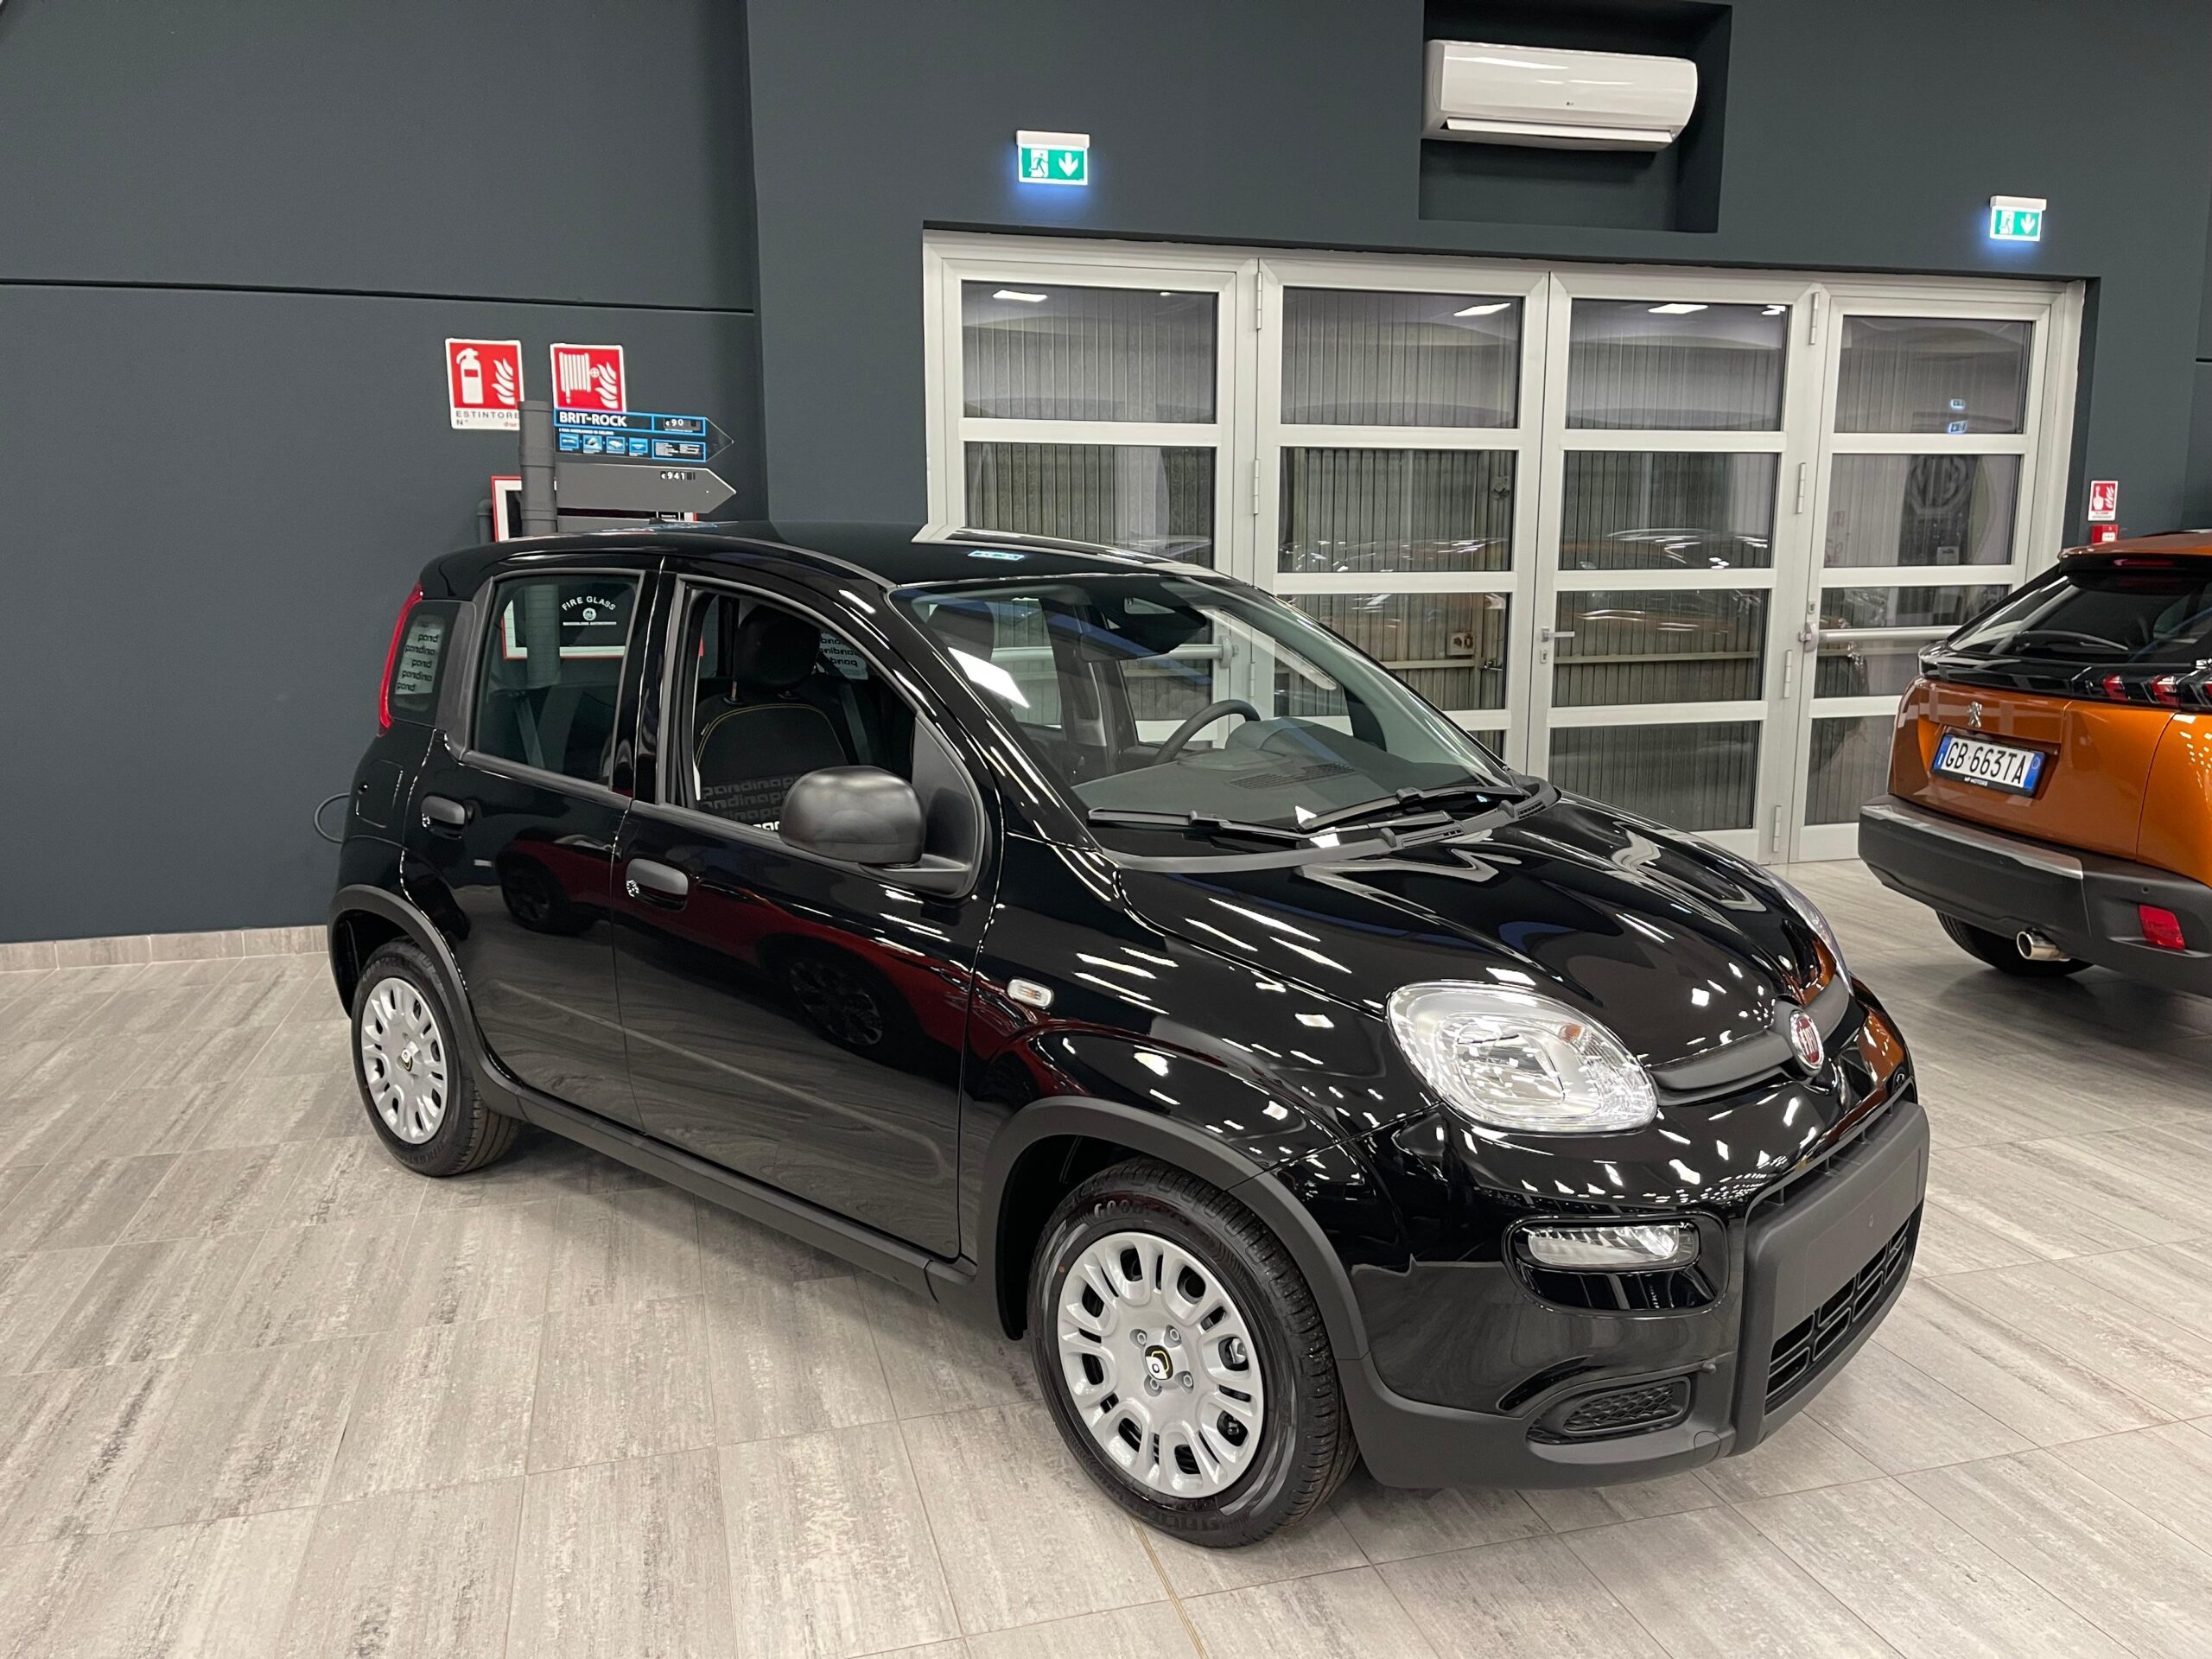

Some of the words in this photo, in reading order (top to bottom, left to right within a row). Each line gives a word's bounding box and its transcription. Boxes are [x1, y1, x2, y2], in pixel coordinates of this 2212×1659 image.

[455, 410, 519, 419] ESTINTORE
[559, 411, 627, 427] BRIT-ROCK
[562, 596, 583, 611] FIRE
[586, 595, 616, 610] GLASS
